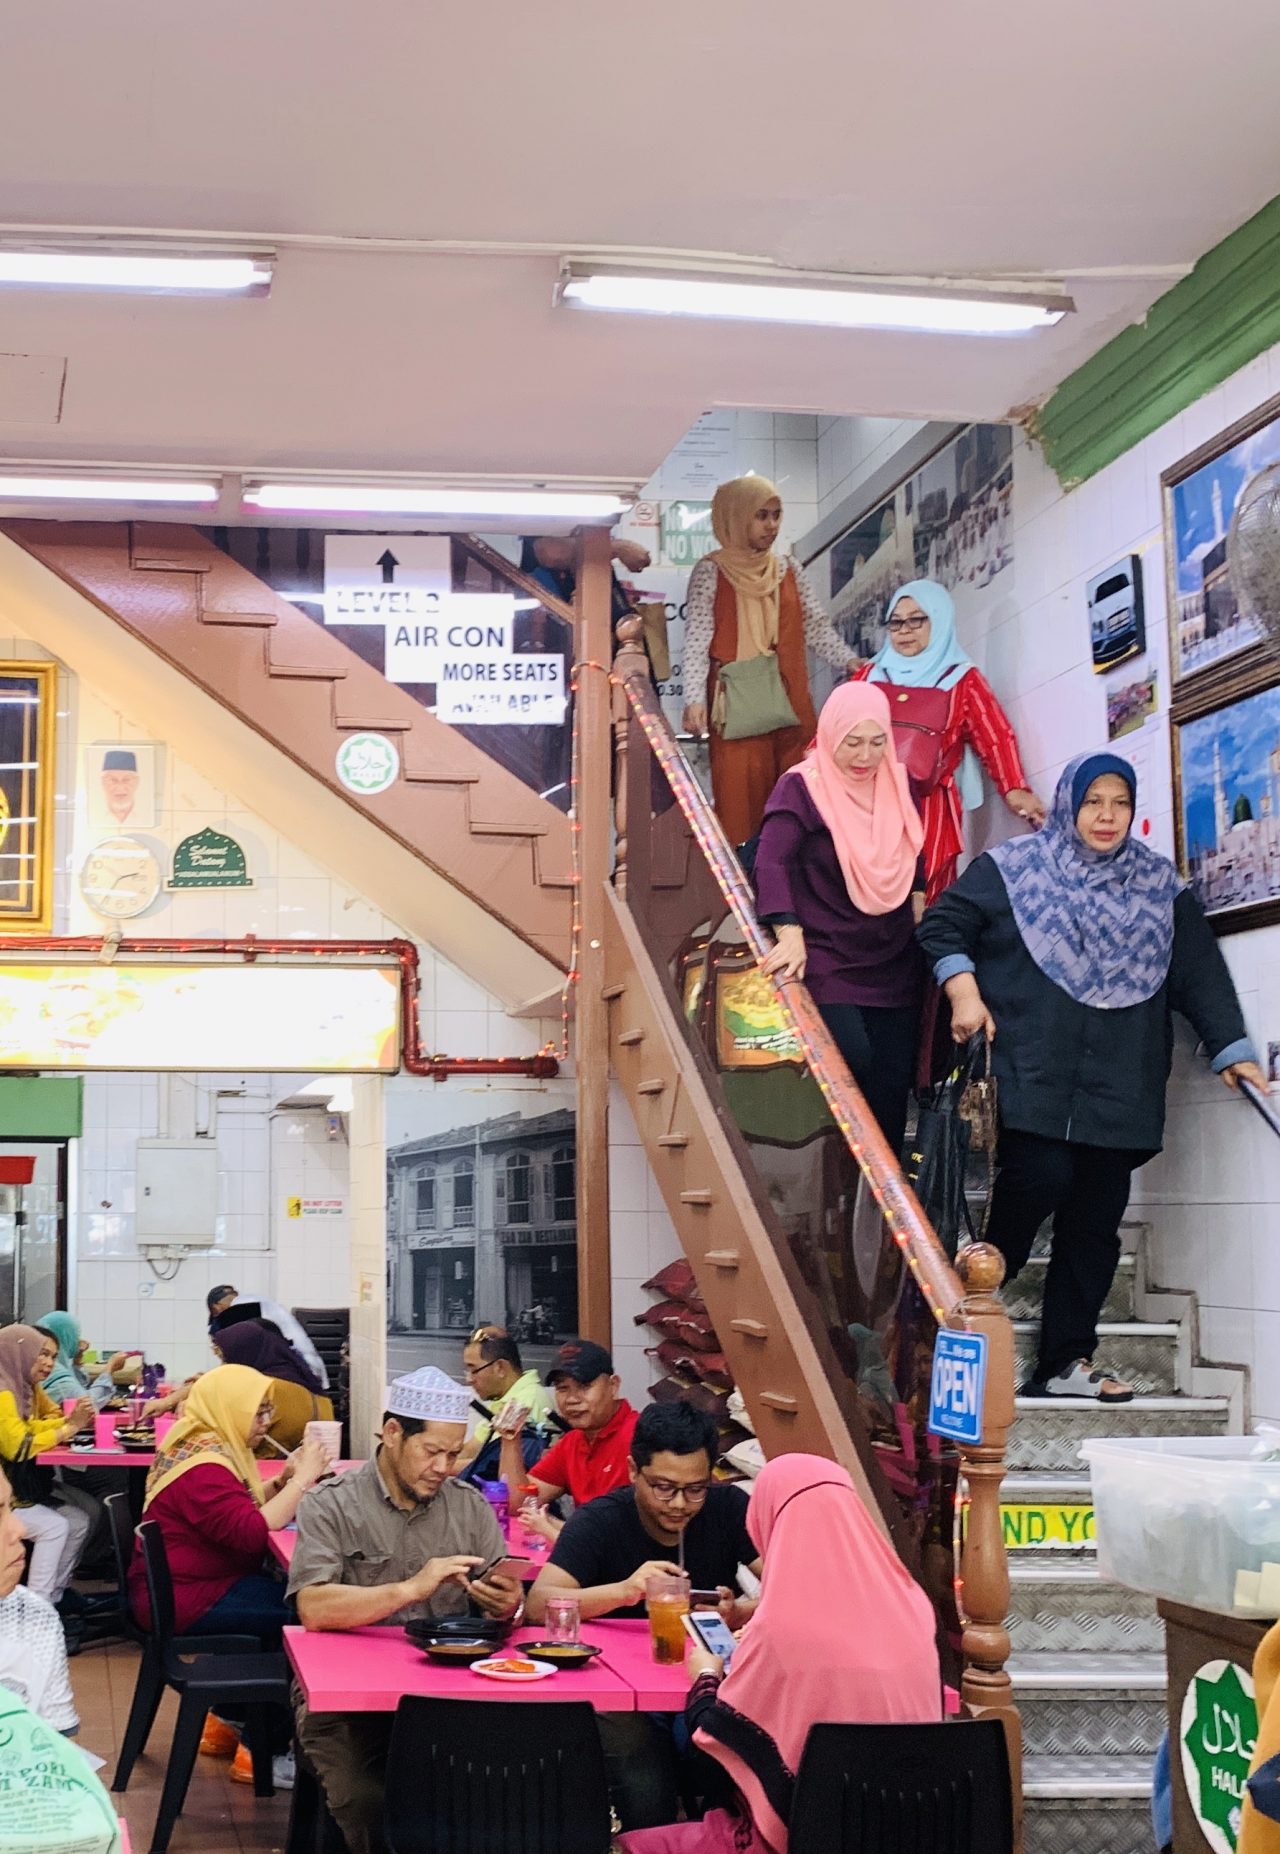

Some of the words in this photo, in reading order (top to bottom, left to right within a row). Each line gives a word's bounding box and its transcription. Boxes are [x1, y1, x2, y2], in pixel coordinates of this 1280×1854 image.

[394, 626, 438, 647] AIR
[447, 626, 504, 647] CON
[443, 663, 496, 681] MORE
[503, 663, 557, 681] SEATS
[933, 1356, 979, 1416] OPEN
[24, 1775, 73, 1792] ZAM
